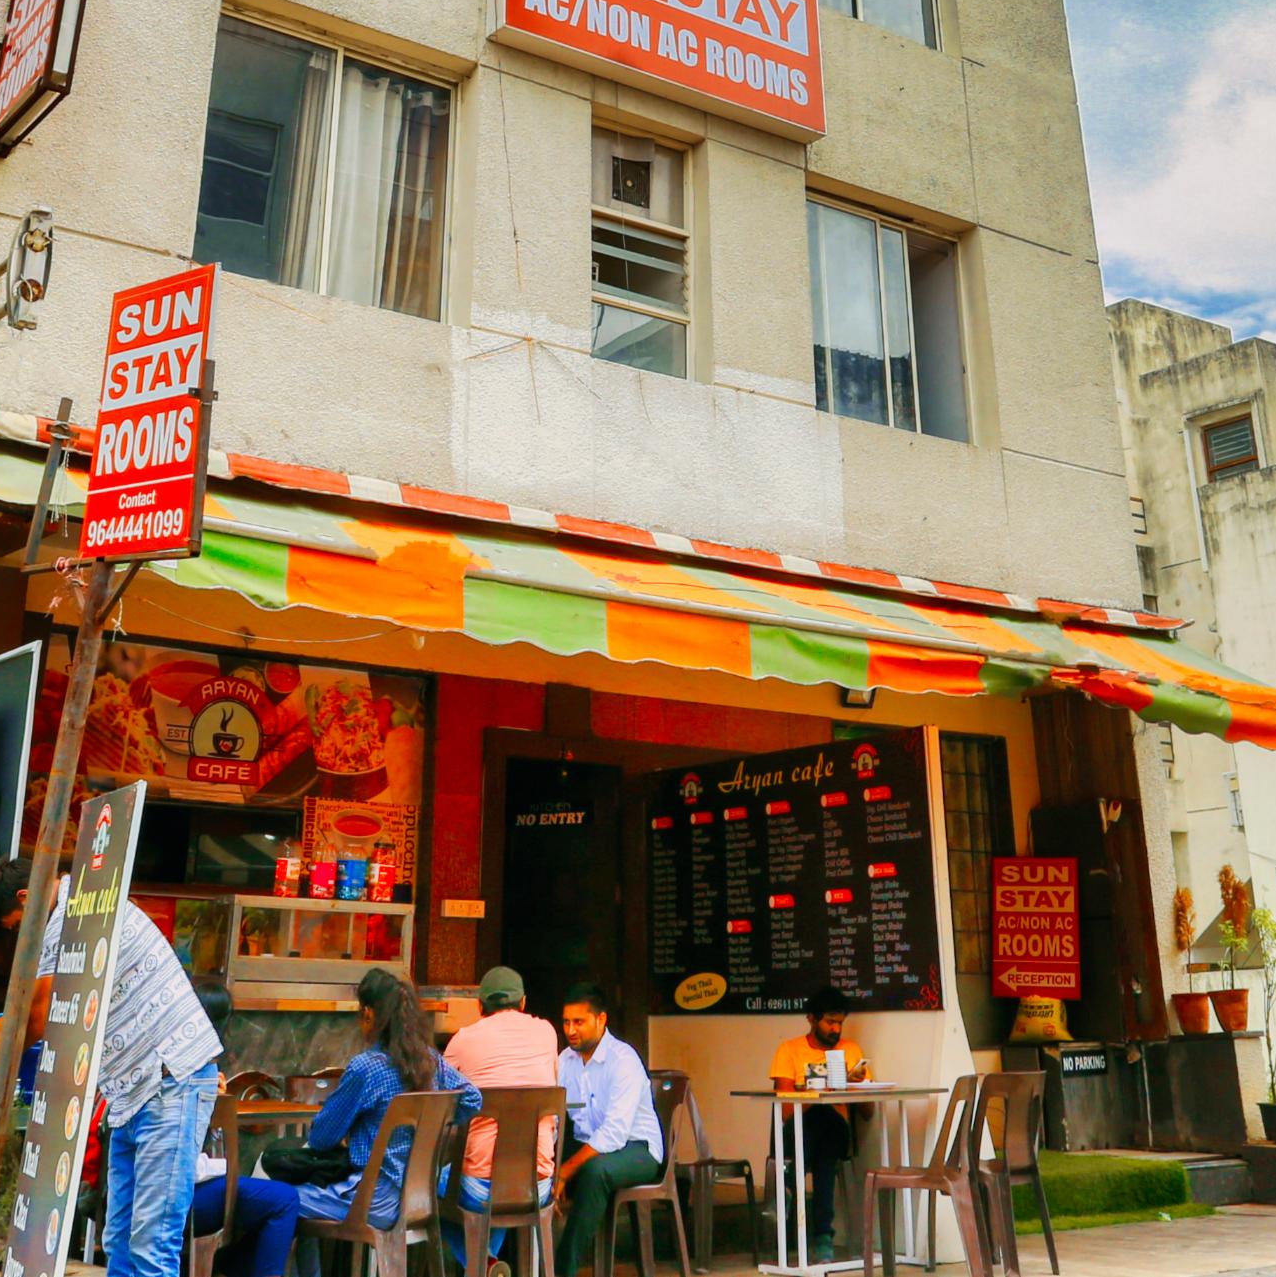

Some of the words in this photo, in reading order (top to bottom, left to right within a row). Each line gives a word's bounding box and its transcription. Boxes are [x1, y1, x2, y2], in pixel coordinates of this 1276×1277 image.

[657, 22, 699, 68] AC
[705, 39, 809, 107] ROOMS
[116, 285, 202, 344] SUN
[108, 343, 198, 401] STAY
[95, 406, 193, 476] ROOMS
[118, 489, 156, 510] Contact
[86, 507, 184, 547] 9644441099
[201, 680, 260, 705] ARYAN
[167, 727, 187, 738] EST
[717, 759, 784, 797] Aryan
[516, 813, 536, 826] NO
[539, 811, 586, 825] ENTRY
[1001, 865, 1069, 884] SUN
[999, 890, 1071, 908] STAY
[998, 916, 1050, 930] AC/NON
[1054, 916, 1073, 930] AC
[998, 933, 1074, 958] ROOMS
[1007, 973, 1071, 985] RECEPTION
[746, 997, 762, 1010] Call
[1063, 1056, 1074, 1071] NO
[1075, 1055, 1105, 1071] PARKING
